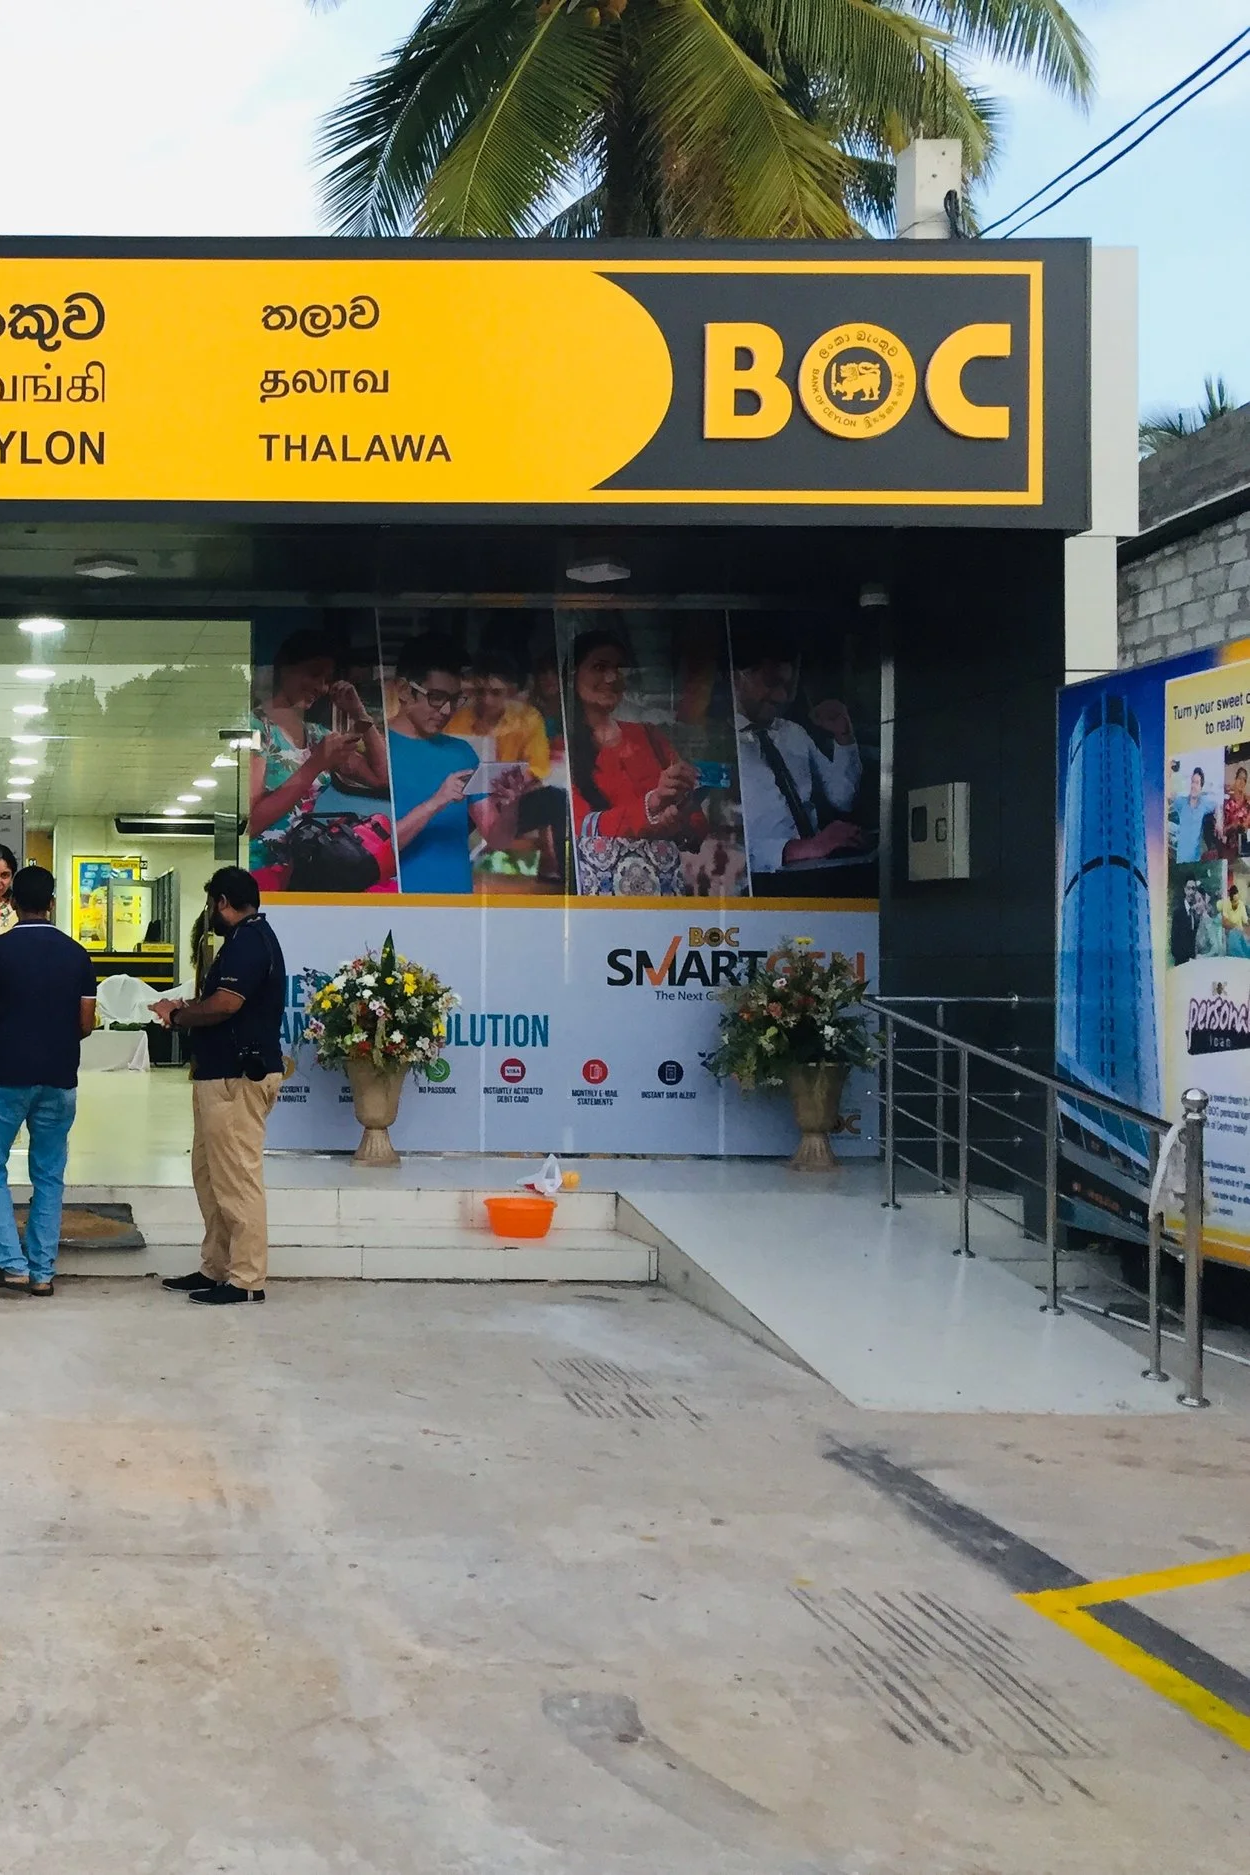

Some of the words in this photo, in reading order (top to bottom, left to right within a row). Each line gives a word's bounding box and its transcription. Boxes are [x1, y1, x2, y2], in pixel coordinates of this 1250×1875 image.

[261, 295, 380, 338] තලාව
[260, 368, 389, 403] தலாவ
[704, 322, 1011, 439] BOC
[259, 433, 452, 462] THALAWA
[1173, 705, 1192, 720] Turn
[1194, 700, 1214, 720] your
[1216, 692, 1243, 711] sweet
[1205, 721, 1214, 735] to
[1216, 714, 1245, 732] reality
[688, 927, 740, 947] BOC
[655, 991, 676, 1001] The
[678, 991, 703, 1001] Next
